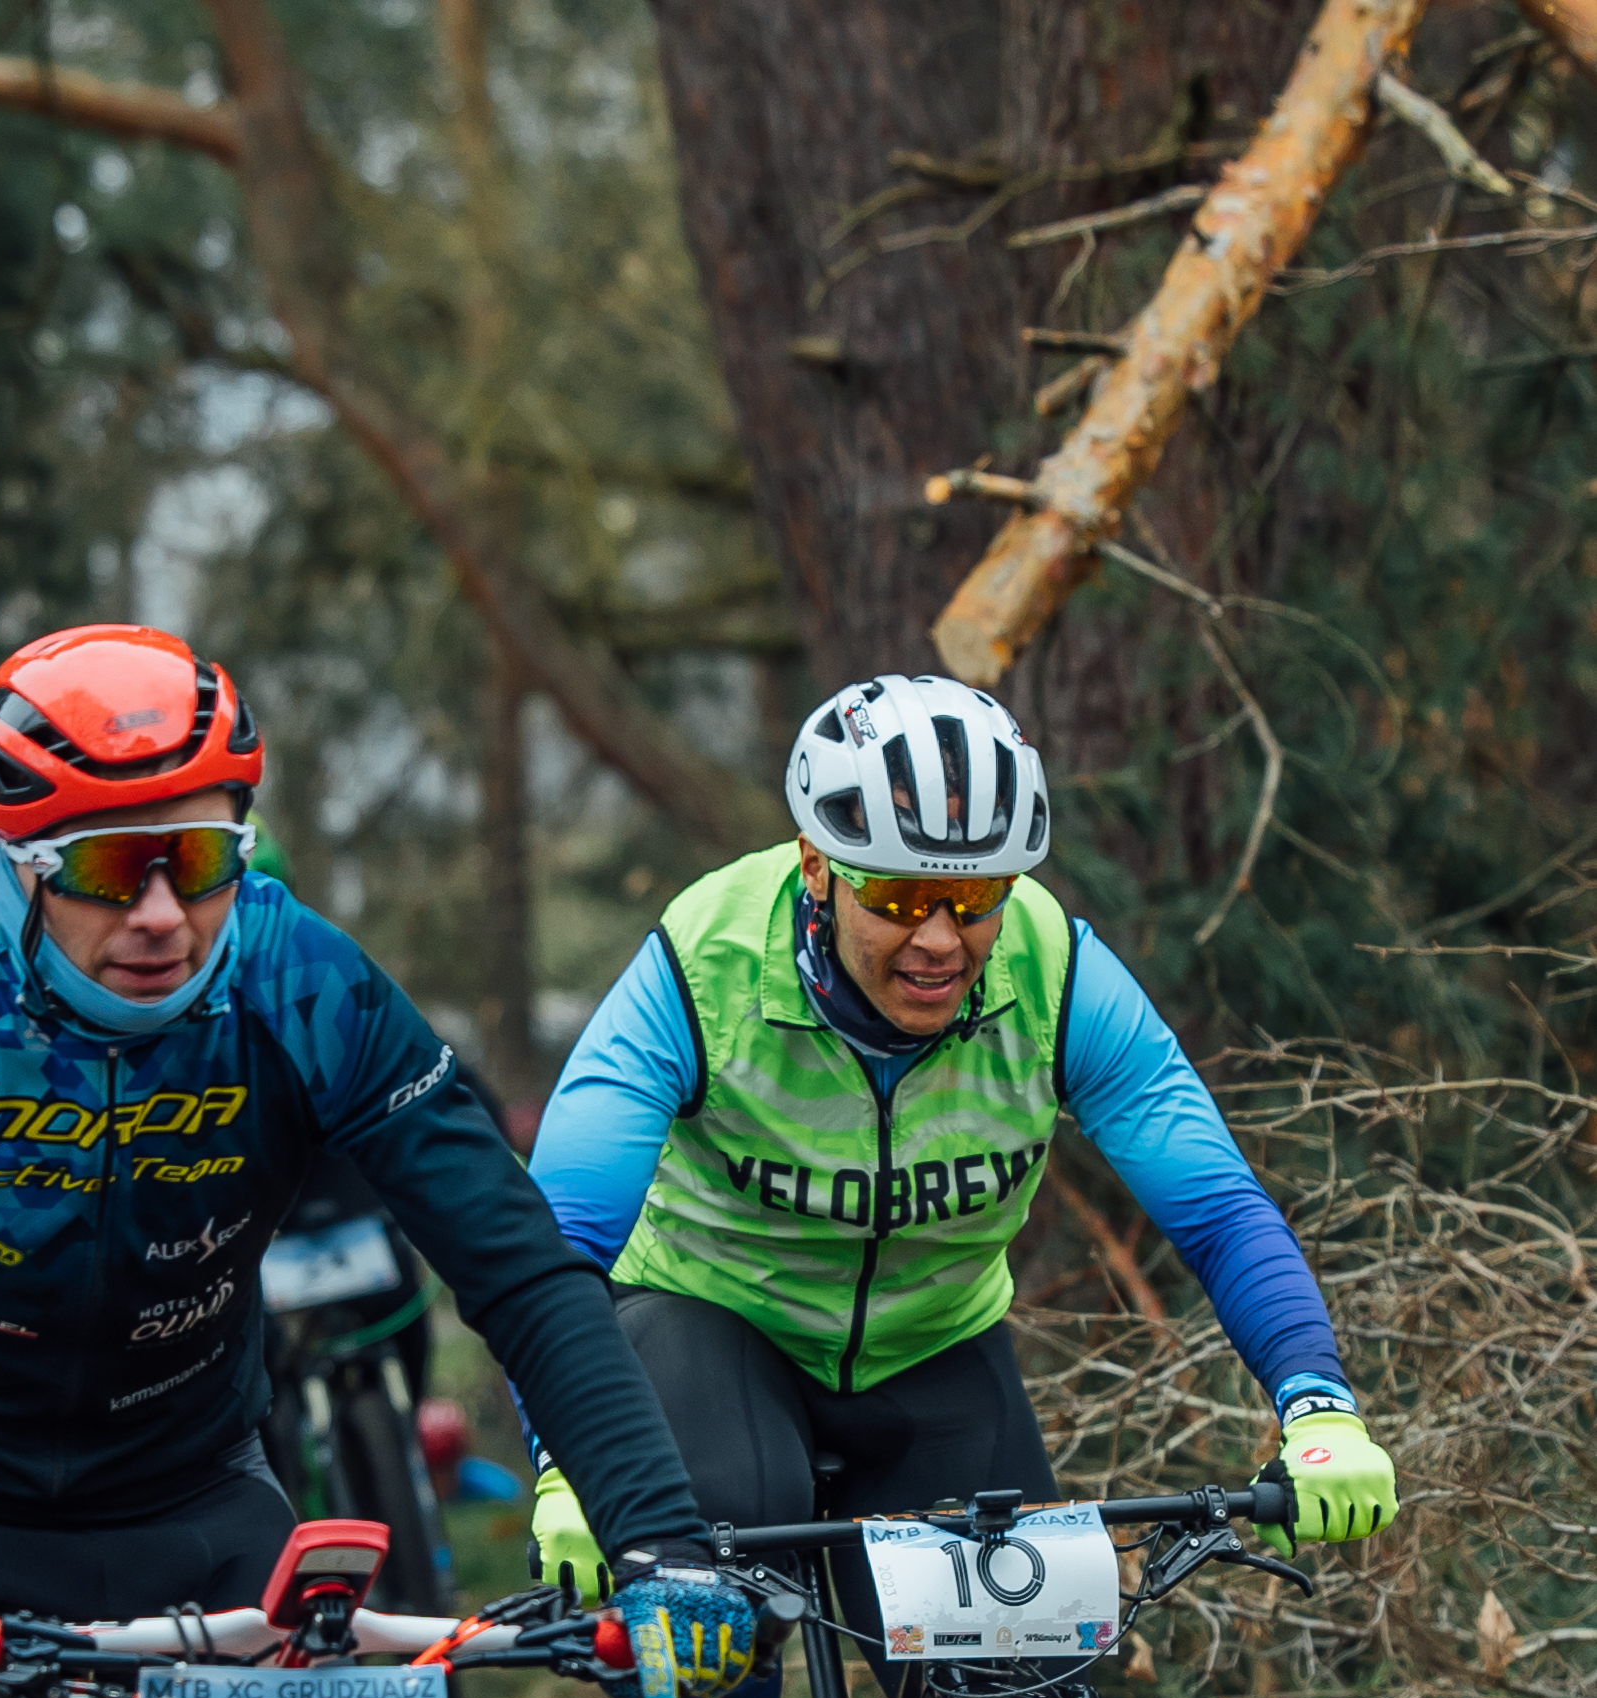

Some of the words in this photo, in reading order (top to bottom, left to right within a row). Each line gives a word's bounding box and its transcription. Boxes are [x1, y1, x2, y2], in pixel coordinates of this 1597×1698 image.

[920, 861, 979, 871] OAKLEY
[132, 1156, 245, 1183] Team
[724, 1142, 1047, 1233] VELOBREW
[139, 1296, 200, 1320] HOTEL
[869, 1525, 921, 1544] MTB
[877, 1564, 897, 1597] 2023
[939, 1536, 1046, 1608] 10
